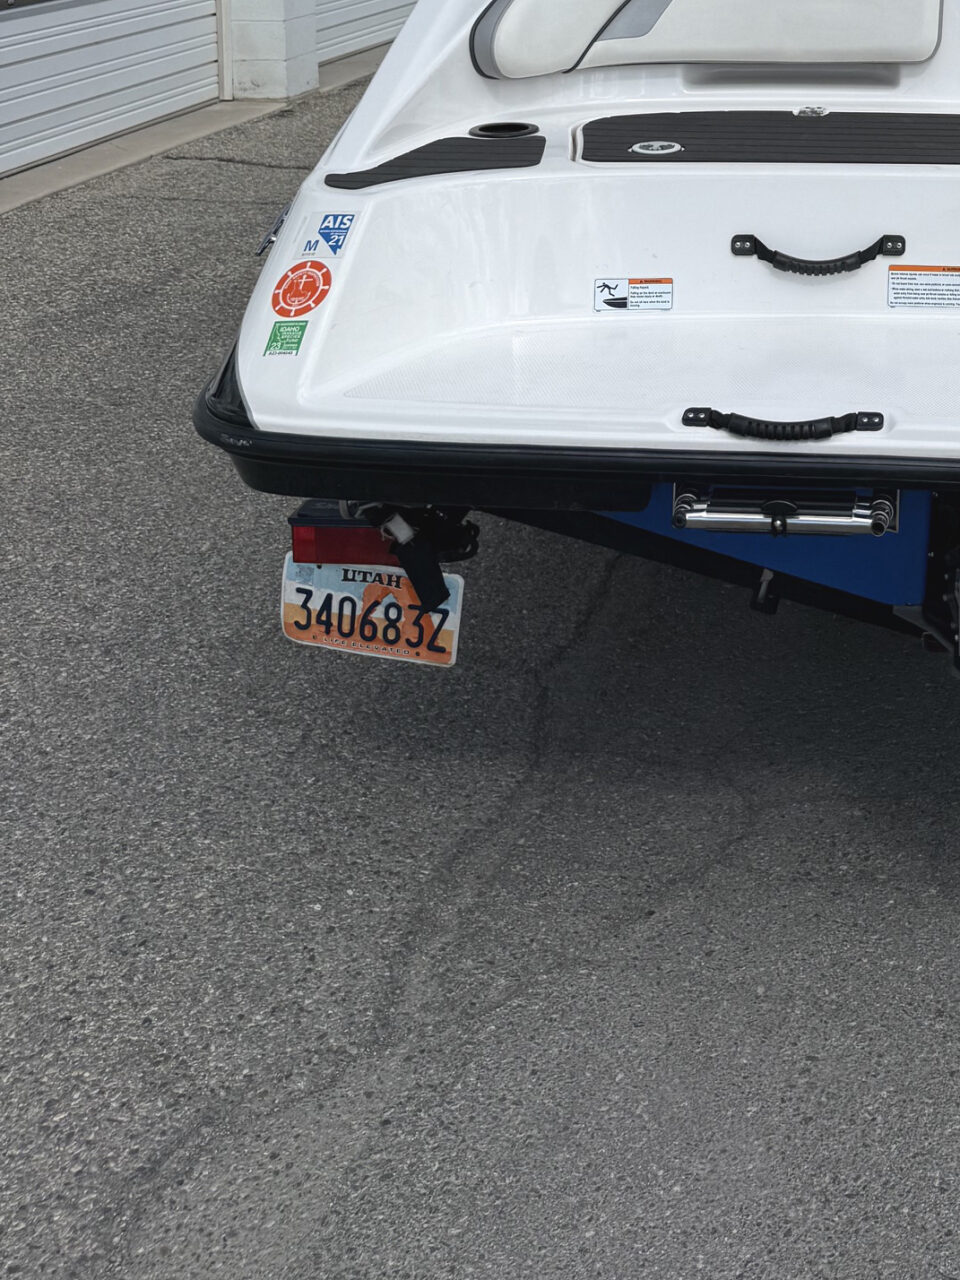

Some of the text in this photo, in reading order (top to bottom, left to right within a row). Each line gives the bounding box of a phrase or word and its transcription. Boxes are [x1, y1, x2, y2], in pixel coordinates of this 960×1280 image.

[321, 215, 353, 229] AIS
[303, 239, 320, 252] M
[328, 235, 345, 246] 21
[270, 342, 281, 351] 23
[341, 568, 403, 590] UTAH
